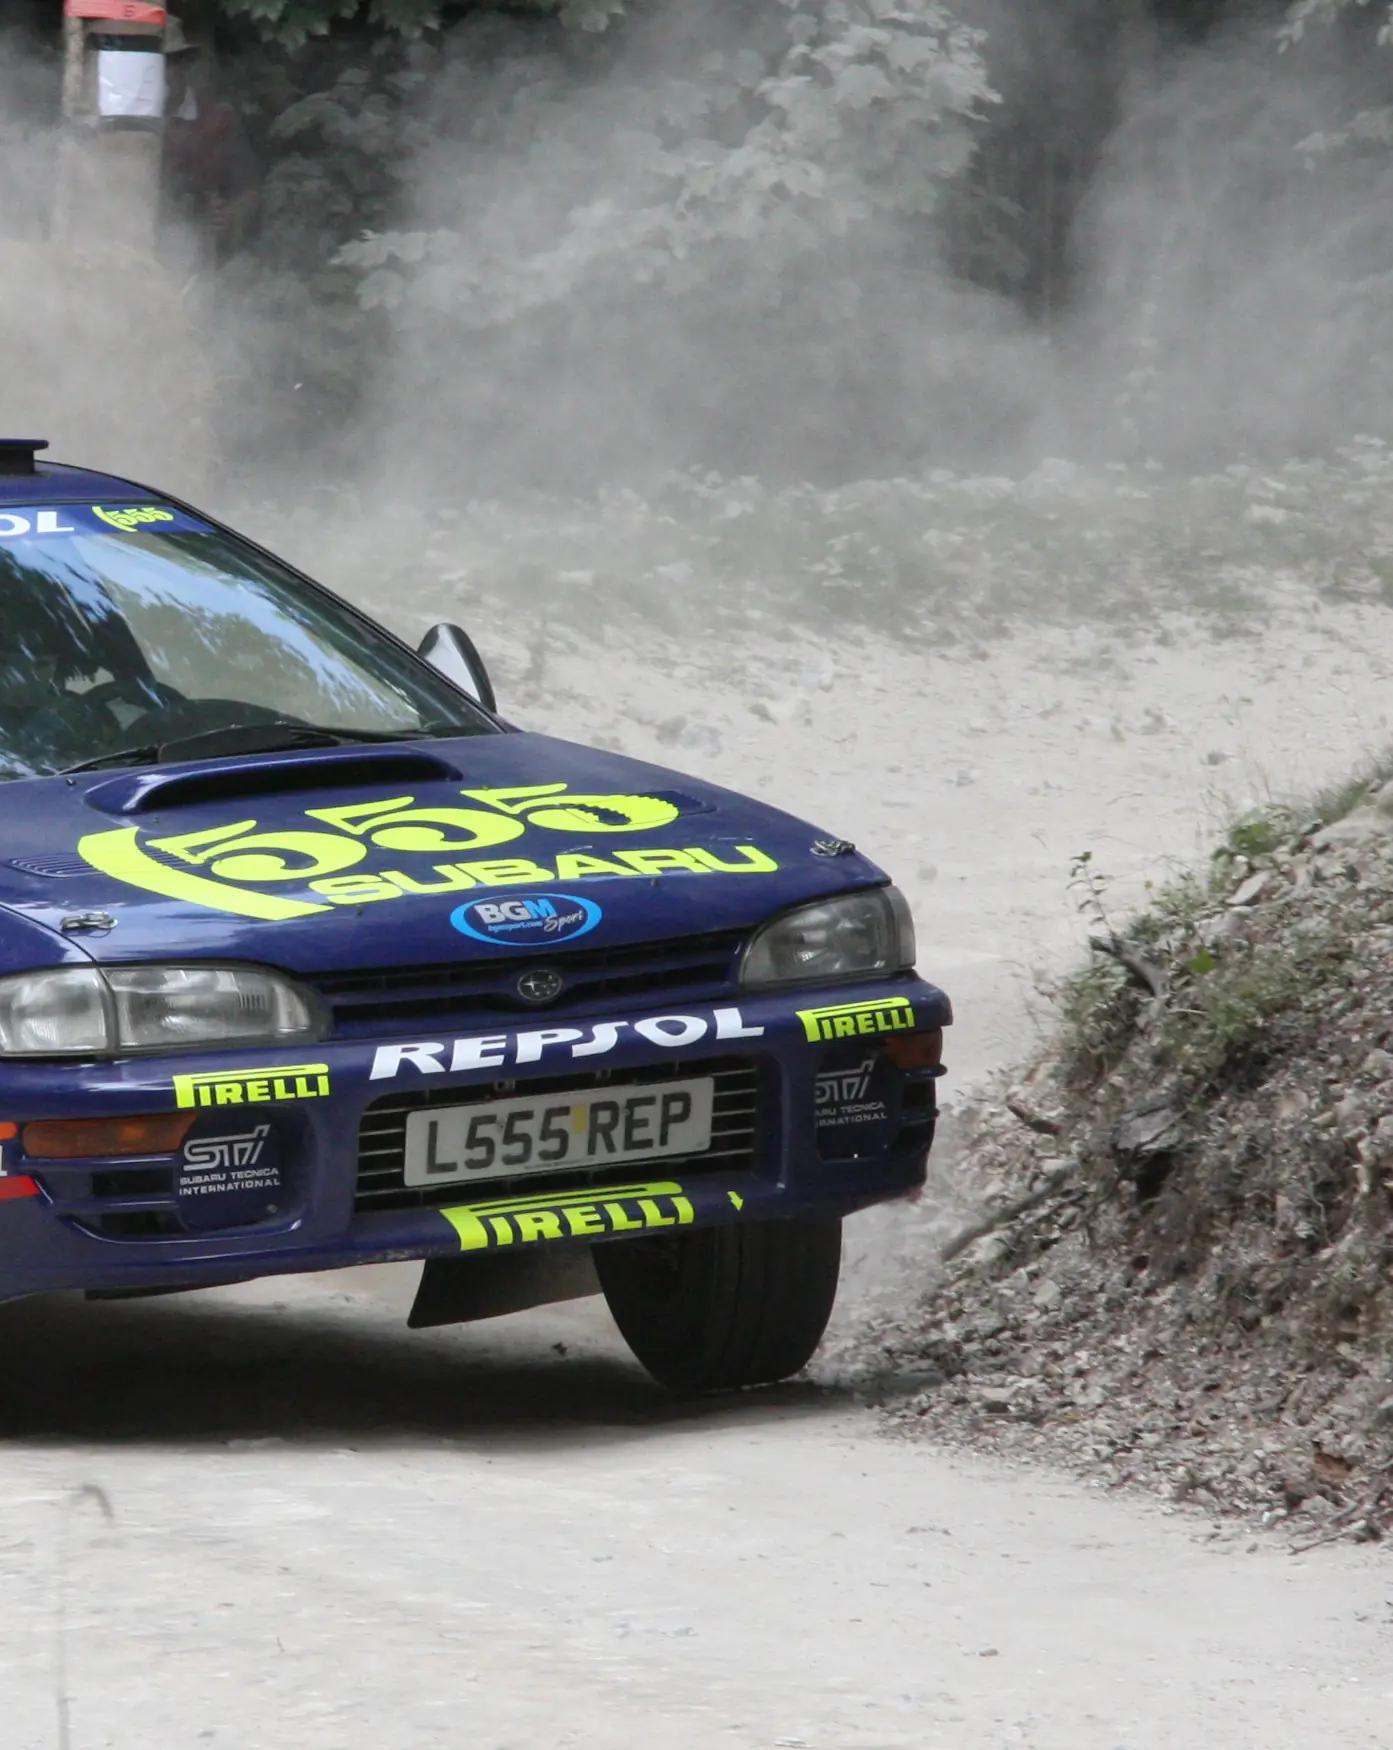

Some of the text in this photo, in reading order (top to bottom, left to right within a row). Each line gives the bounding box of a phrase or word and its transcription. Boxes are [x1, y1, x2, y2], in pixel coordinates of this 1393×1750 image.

[146, 783, 679, 882] 555
[308, 843, 779, 906] SUBARU
[474, 899, 558, 924] BGM
[543, 909, 584, 932] Sport
[795, 997, 914, 1042] PIRELLI
[369, 1008, 764, 1080] REPSOL
[173, 1063, 330, 1108] PIRELLI
[425, 1091, 692, 1175] L555 REP
[179, 1167, 280, 1186] SUBARU TECNICA
[179, 1178, 282, 1197] INTERNATIONAL
[440, 1181, 695, 1251] PIRELLI
